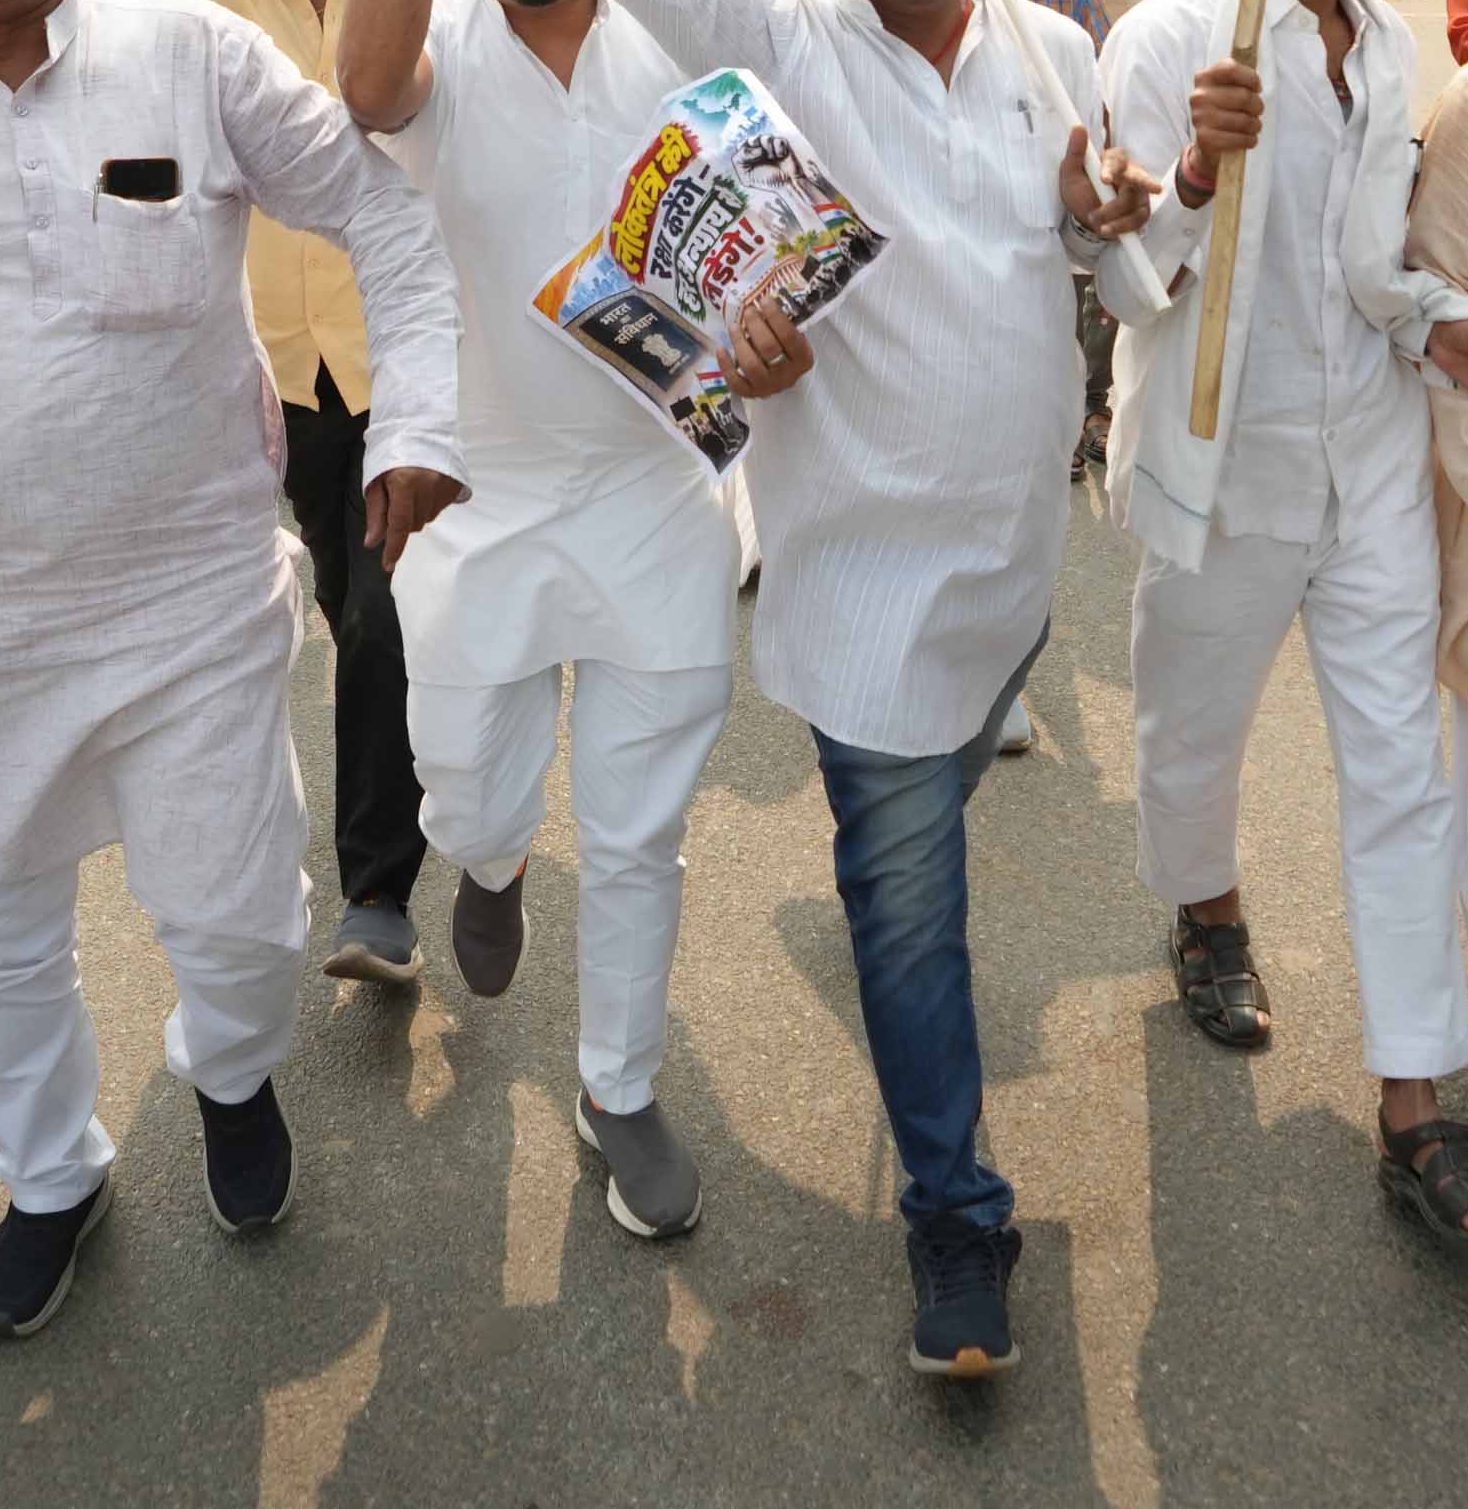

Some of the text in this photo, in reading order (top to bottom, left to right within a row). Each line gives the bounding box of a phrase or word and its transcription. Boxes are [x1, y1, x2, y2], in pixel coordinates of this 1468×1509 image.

[611, 124, 692, 274] लोकतंत्र की
[650, 230, 674, 280] रक्षा
[662, 175, 707, 238] करेंगे
[599, 302, 632, 326] भारत
